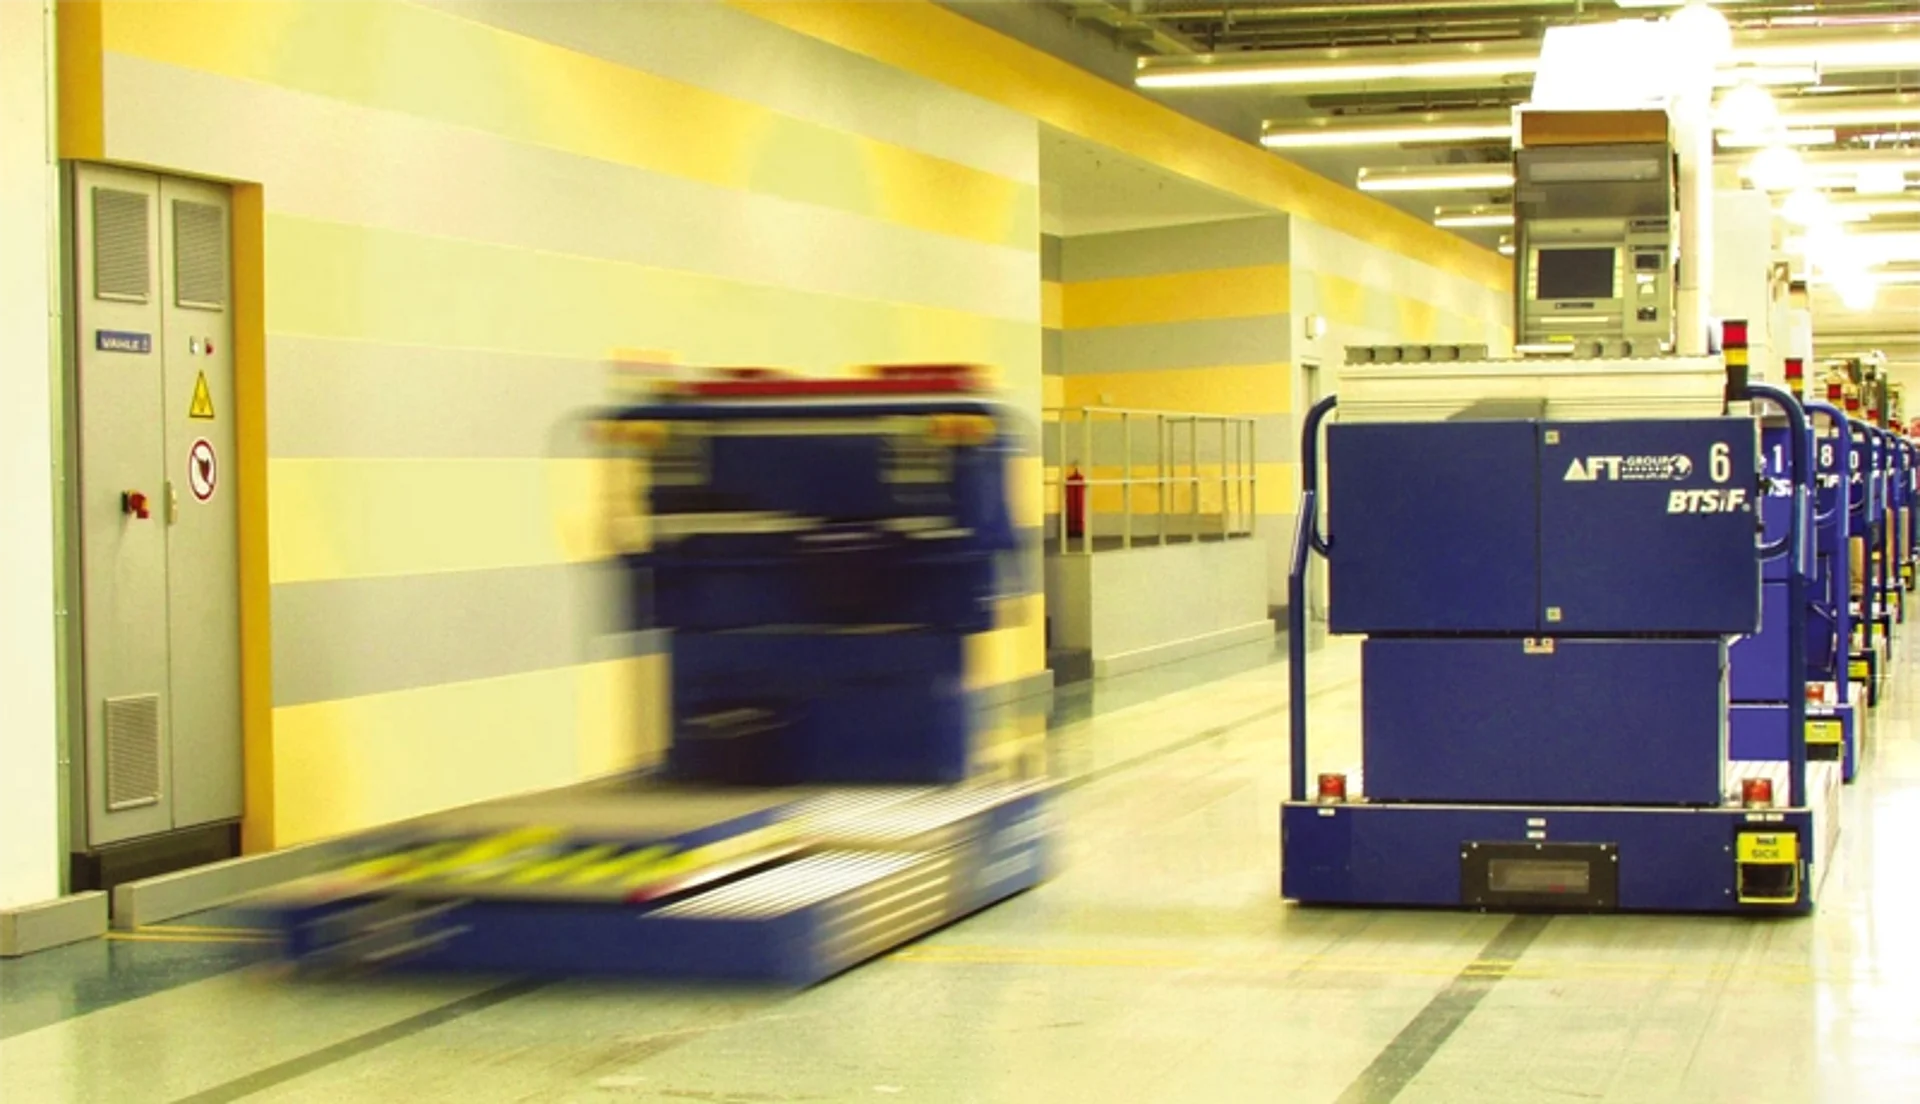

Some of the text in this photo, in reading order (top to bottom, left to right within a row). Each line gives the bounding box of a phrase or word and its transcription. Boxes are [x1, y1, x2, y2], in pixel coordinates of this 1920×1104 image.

[1564, 456, 1622, 480] AFT
[1710, 442, 1731, 483] 6
[1773, 444, 1782, 474] 1
[1821, 444, 1833, 467] 8
